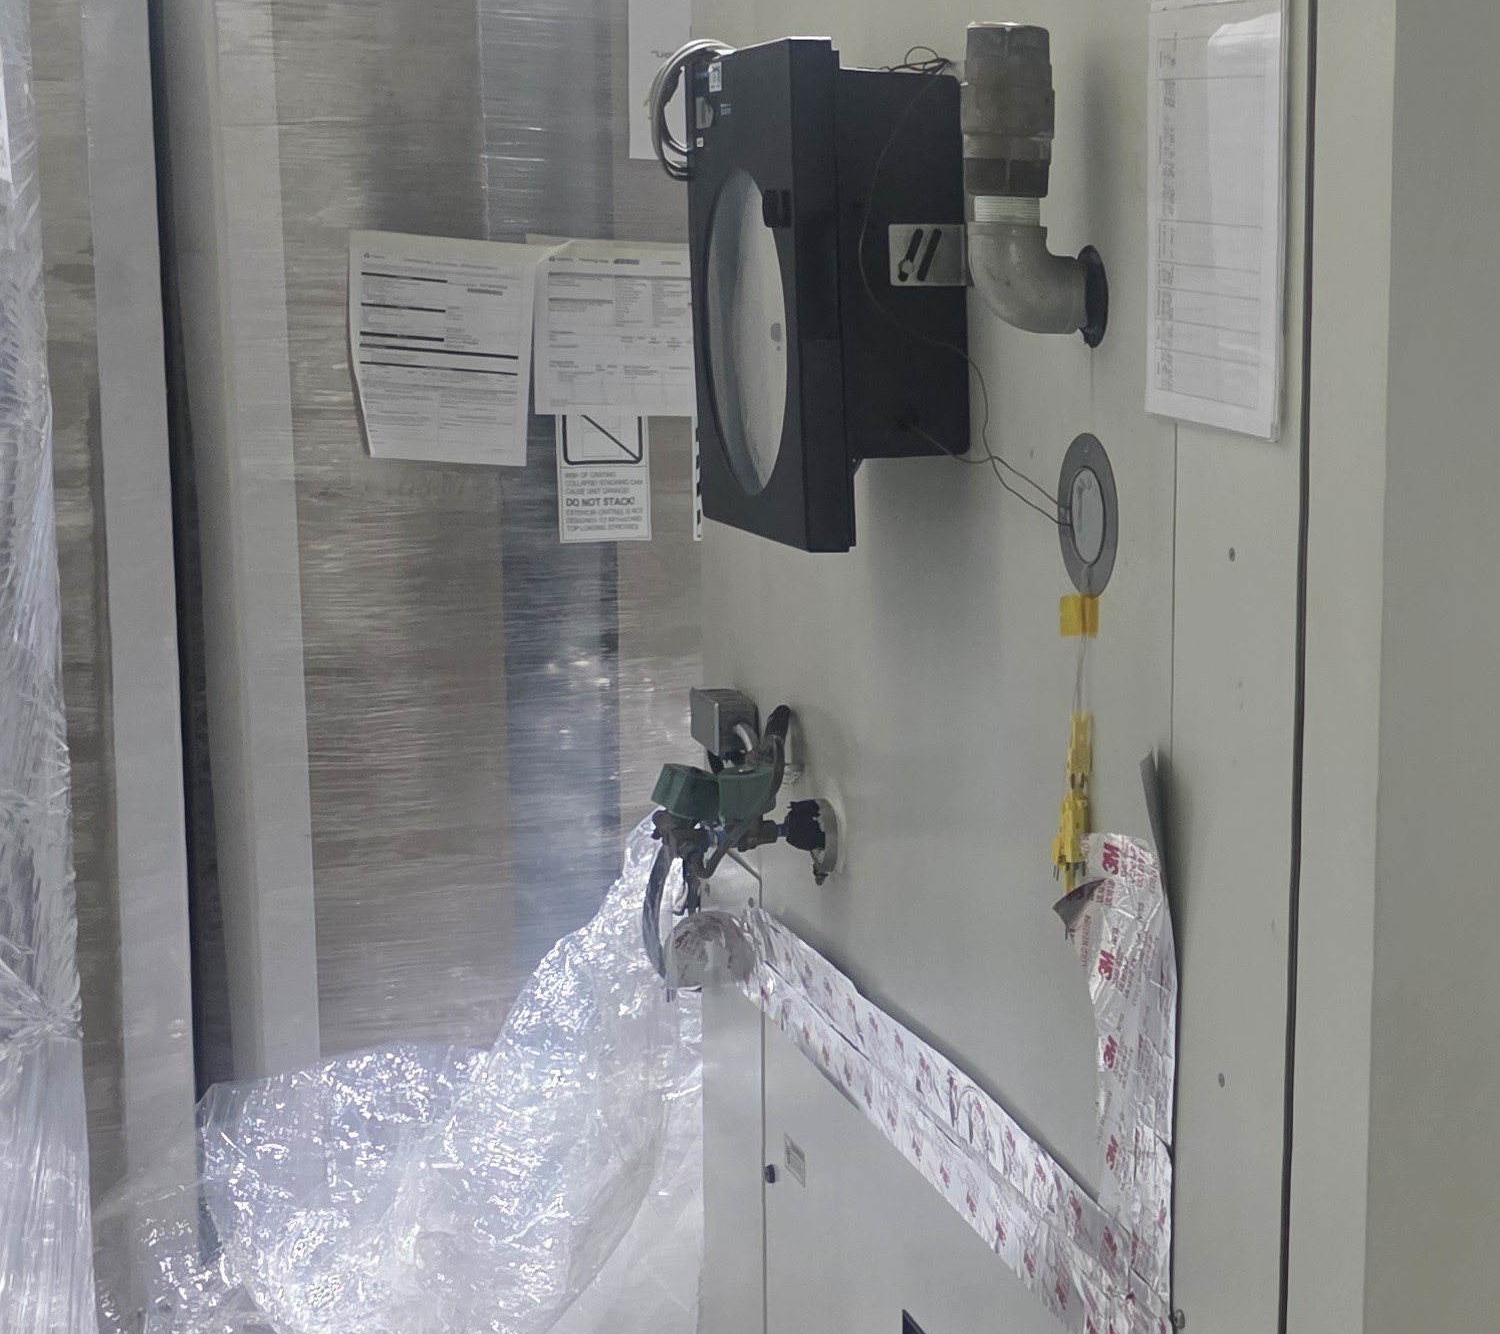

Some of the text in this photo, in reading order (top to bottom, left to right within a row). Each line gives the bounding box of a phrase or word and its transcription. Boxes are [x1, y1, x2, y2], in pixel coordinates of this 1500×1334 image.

[566, 497, 580, 507] DO
[581, 497, 601, 507] NOT
[1102, 842, 1119, 875] 3M
[1098, 949, 1115, 981] 3M
[1103, 1035, 1118, 1069] 3M
[1106, 1134, 1119, 1171] 3M
